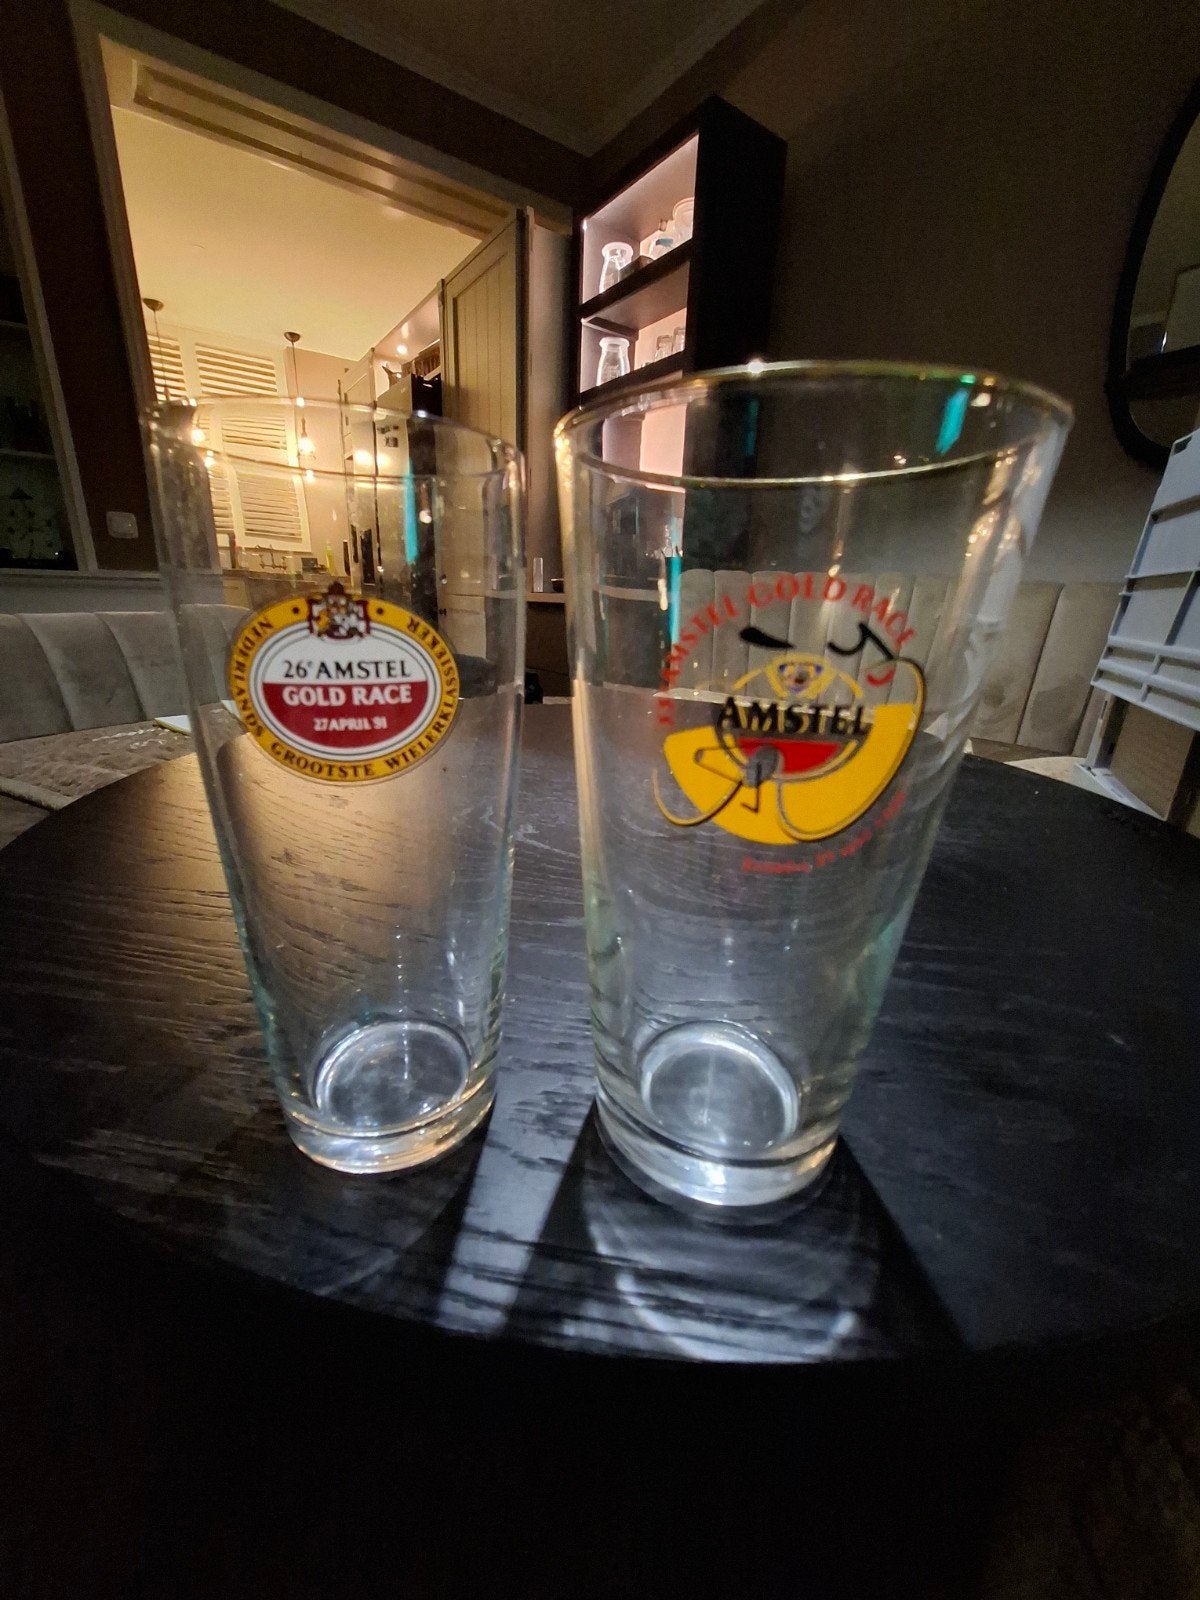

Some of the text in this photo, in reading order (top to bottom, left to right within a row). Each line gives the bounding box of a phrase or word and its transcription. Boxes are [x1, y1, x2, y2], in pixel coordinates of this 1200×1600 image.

[747, 572, 847, 609] GOLD
[852, 583, 916, 651] RACE
[316, 660, 411, 680] AMSTEL
[282, 683, 413, 707] GOLD RACE
[717, 697, 873, 737] AMSTEL
[270, 740, 376, 778] GROOTSTE
